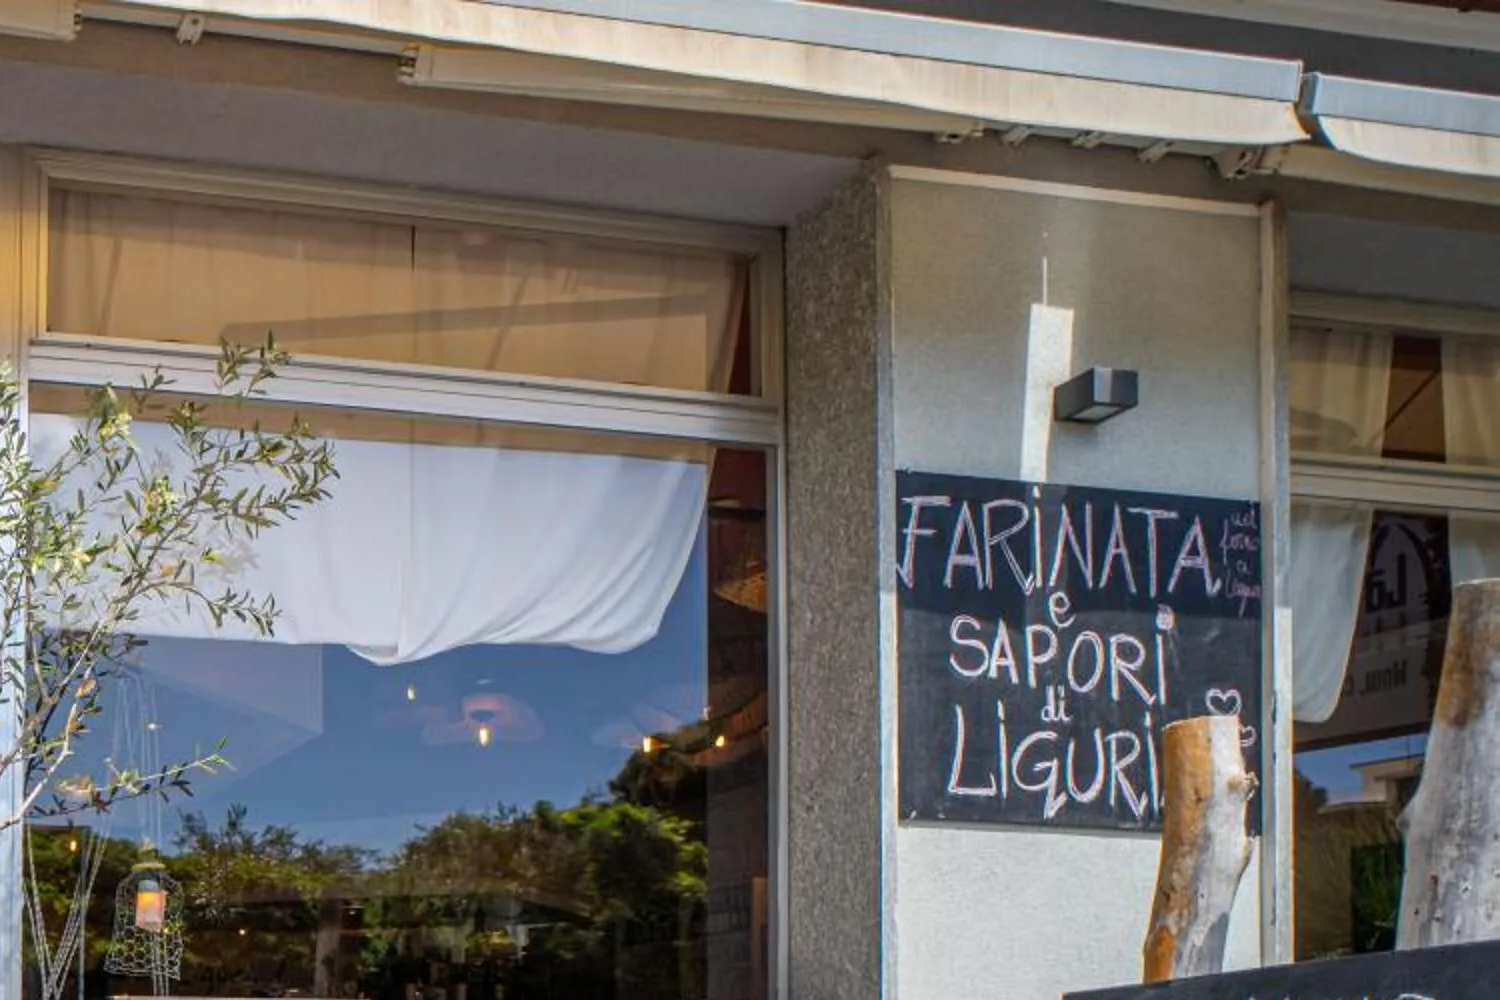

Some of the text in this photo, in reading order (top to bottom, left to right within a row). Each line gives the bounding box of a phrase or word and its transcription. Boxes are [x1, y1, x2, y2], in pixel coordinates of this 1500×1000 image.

[1049, 590, 1075, 629] e
[949, 603, 1175, 705] SAPORI
[1042, 686, 1073, 724] di
[948, 700, 1165, 820] LIGURI
